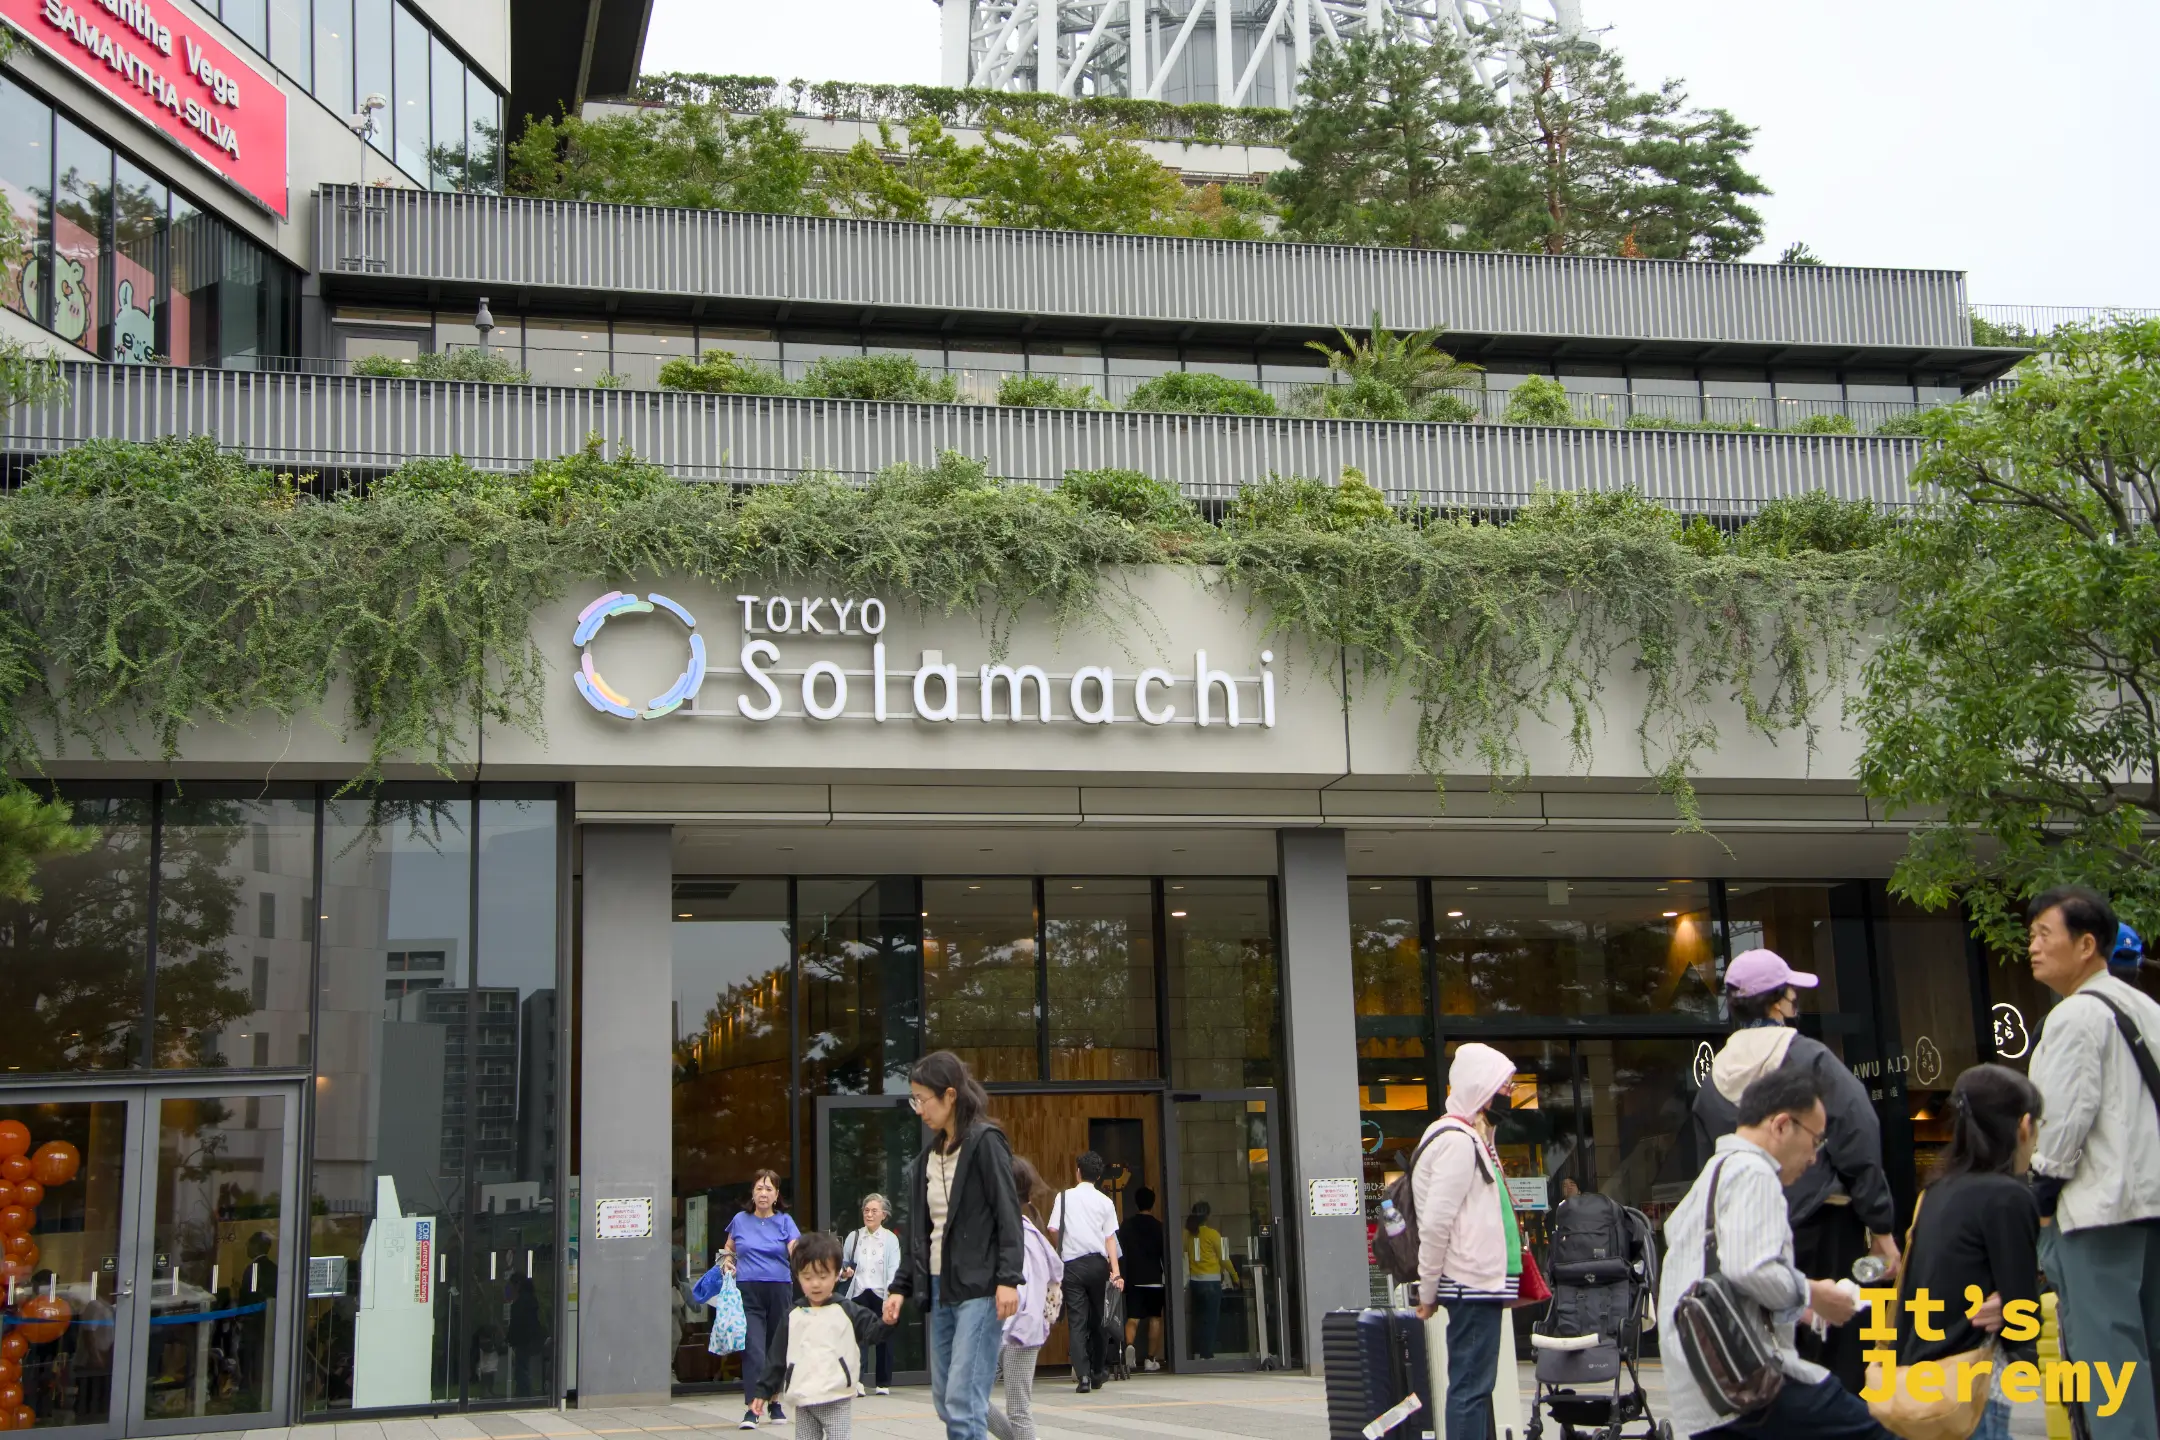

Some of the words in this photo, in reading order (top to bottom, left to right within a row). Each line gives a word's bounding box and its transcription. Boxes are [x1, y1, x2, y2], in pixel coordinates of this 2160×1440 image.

[40, 0, 181, 116] SAMANTHA
[181, 97, 240, 160] SILVA
[180, 34, 240, 109] Vega
[736, 595, 887, 634] TOKYO
[737, 639, 1277, 729] Solamachi
[422, 1222, 430, 1240] CDR
[421, 1241, 429, 1269] Currency
[420, 1270, 428, 1303] Exchange
